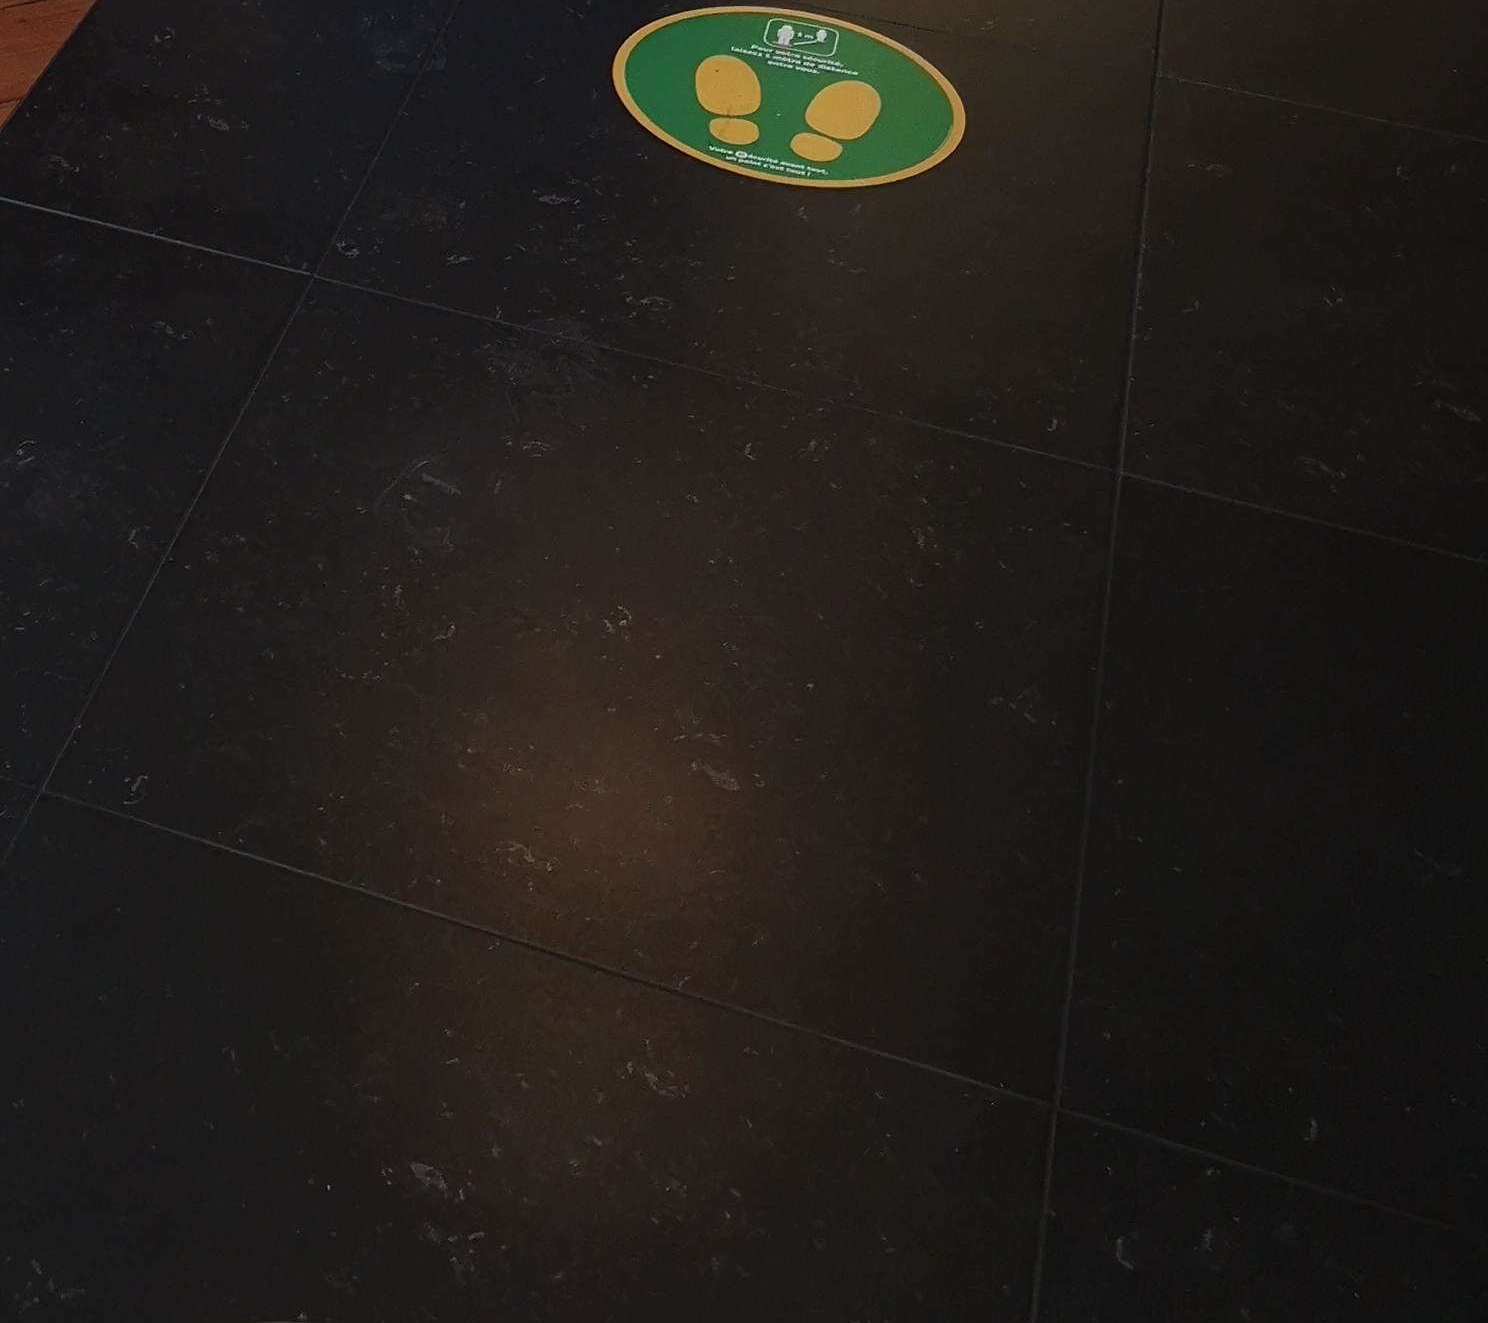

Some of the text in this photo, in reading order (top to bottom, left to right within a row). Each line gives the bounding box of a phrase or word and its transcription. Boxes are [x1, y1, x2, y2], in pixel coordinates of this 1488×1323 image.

[750, 44, 773, 53] Pour
[775, 49, 801, 58] votre
[767, 60, 793, 69] entre
[817, 64, 858, 75] distance
[708, 145, 734, 155] Votre
[780, 160, 805, 169] avant
[738, 158, 762, 166] point
[763, 163, 785, 171] c'est
[786, 167, 806, 176] tout
